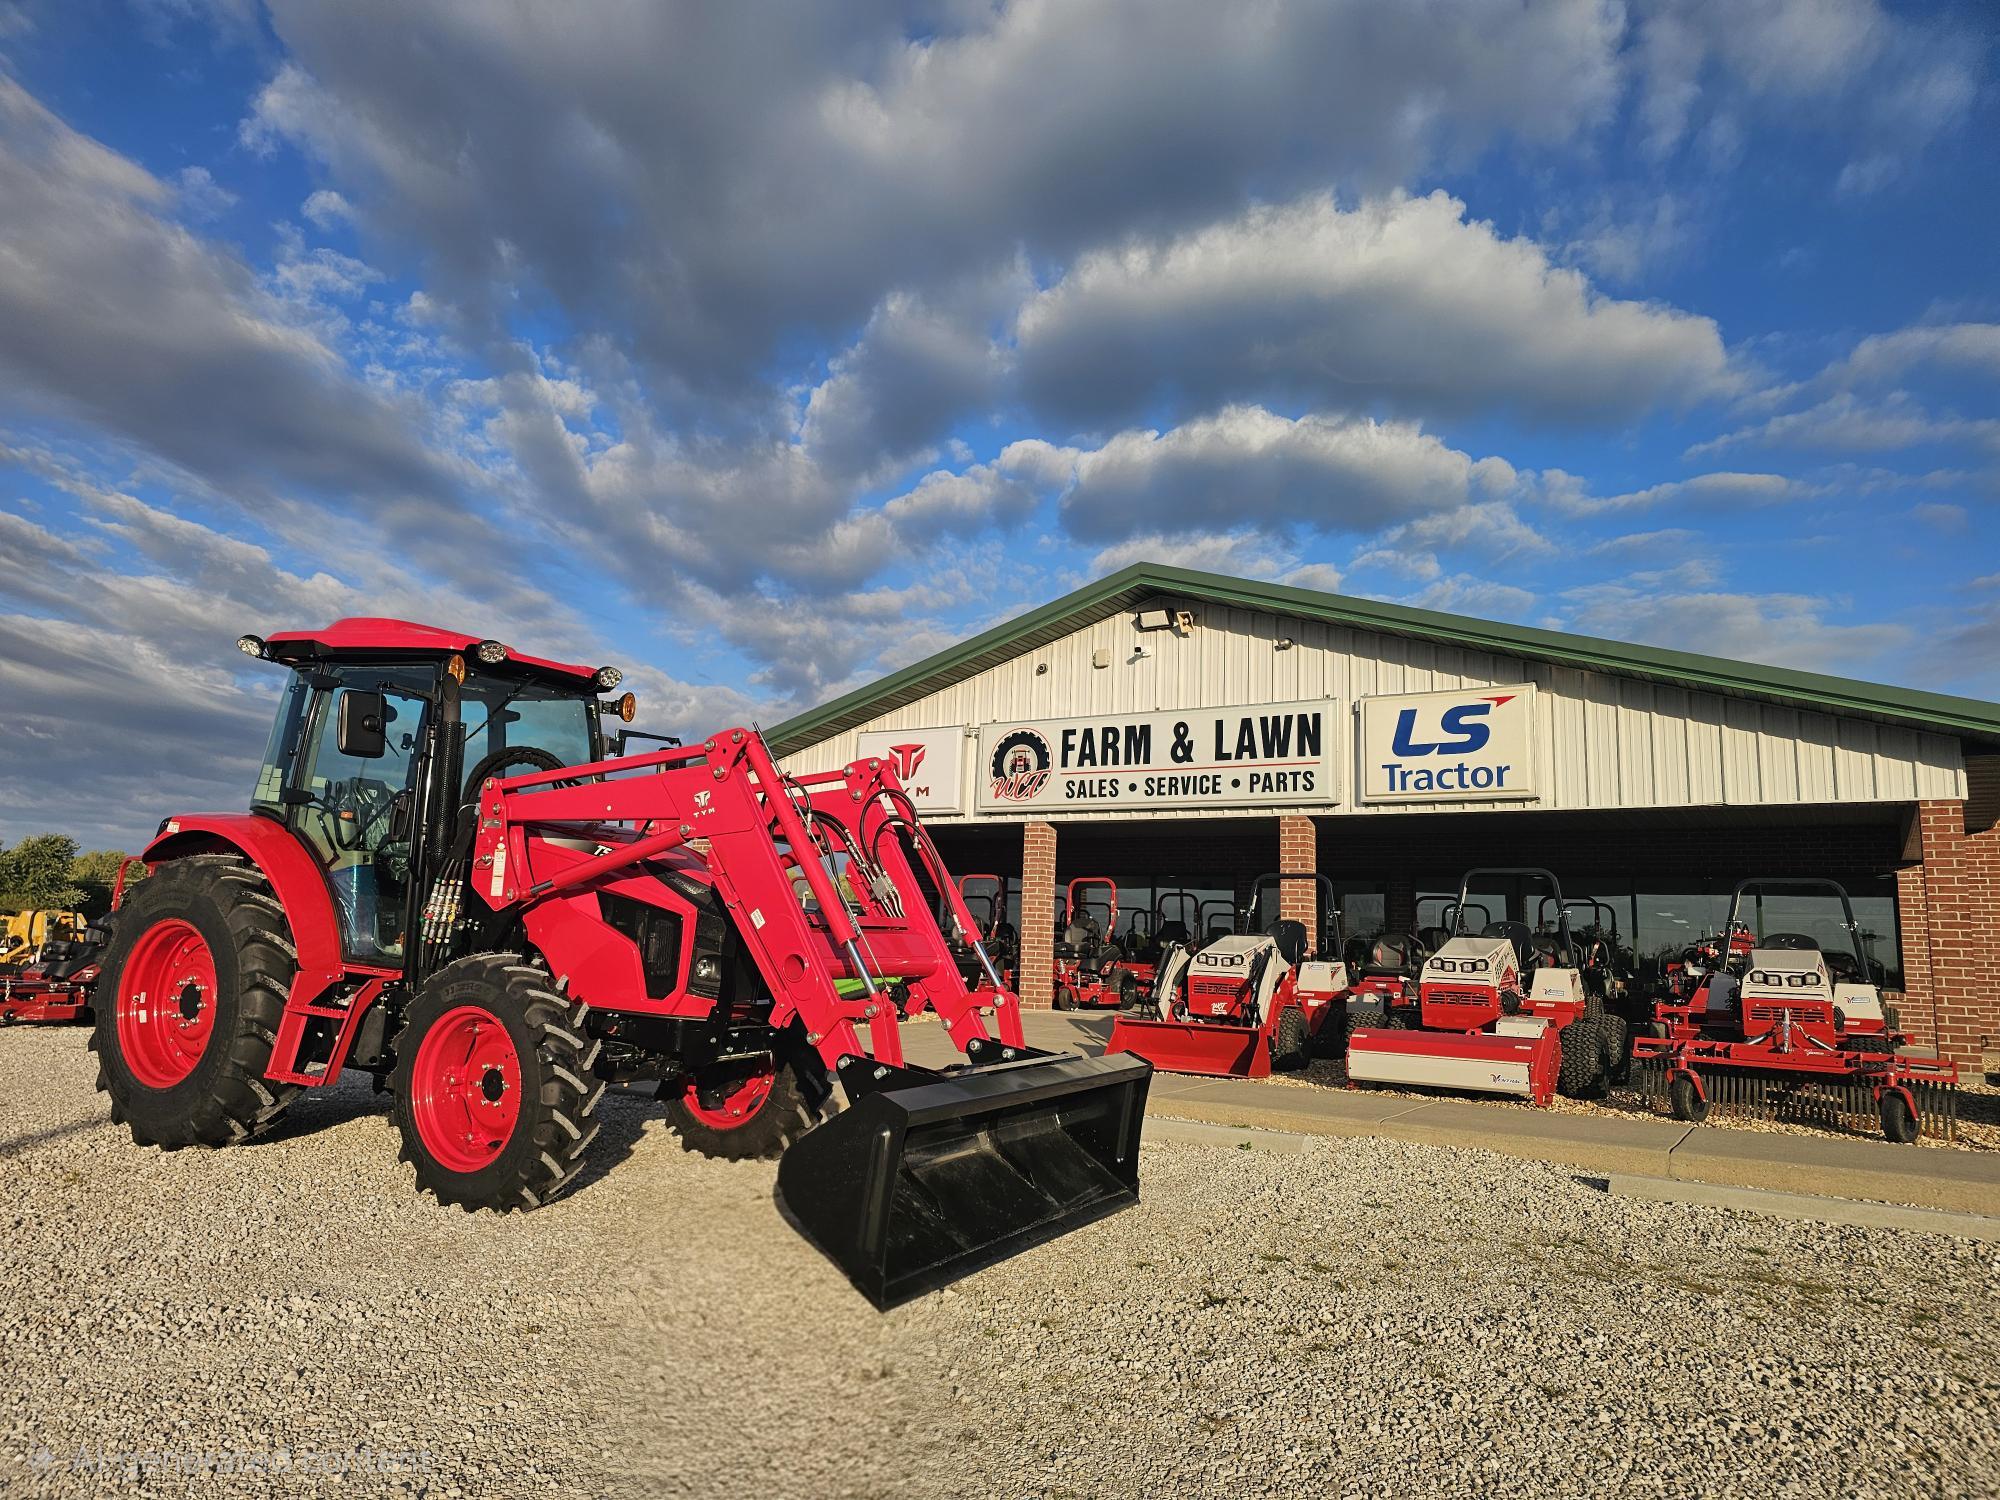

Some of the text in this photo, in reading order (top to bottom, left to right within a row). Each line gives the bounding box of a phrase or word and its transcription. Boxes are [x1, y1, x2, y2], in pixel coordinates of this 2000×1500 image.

[1060, 713, 1322, 768] FARM & LAWN
[1391, 703, 1492, 758] LS
[988, 769, 1052, 799] WCT
[1065, 770, 1315, 799] SALES SERVICE PARTS
[1381, 762, 1511, 792] Tractor
[692, 807, 716, 818] TYM
